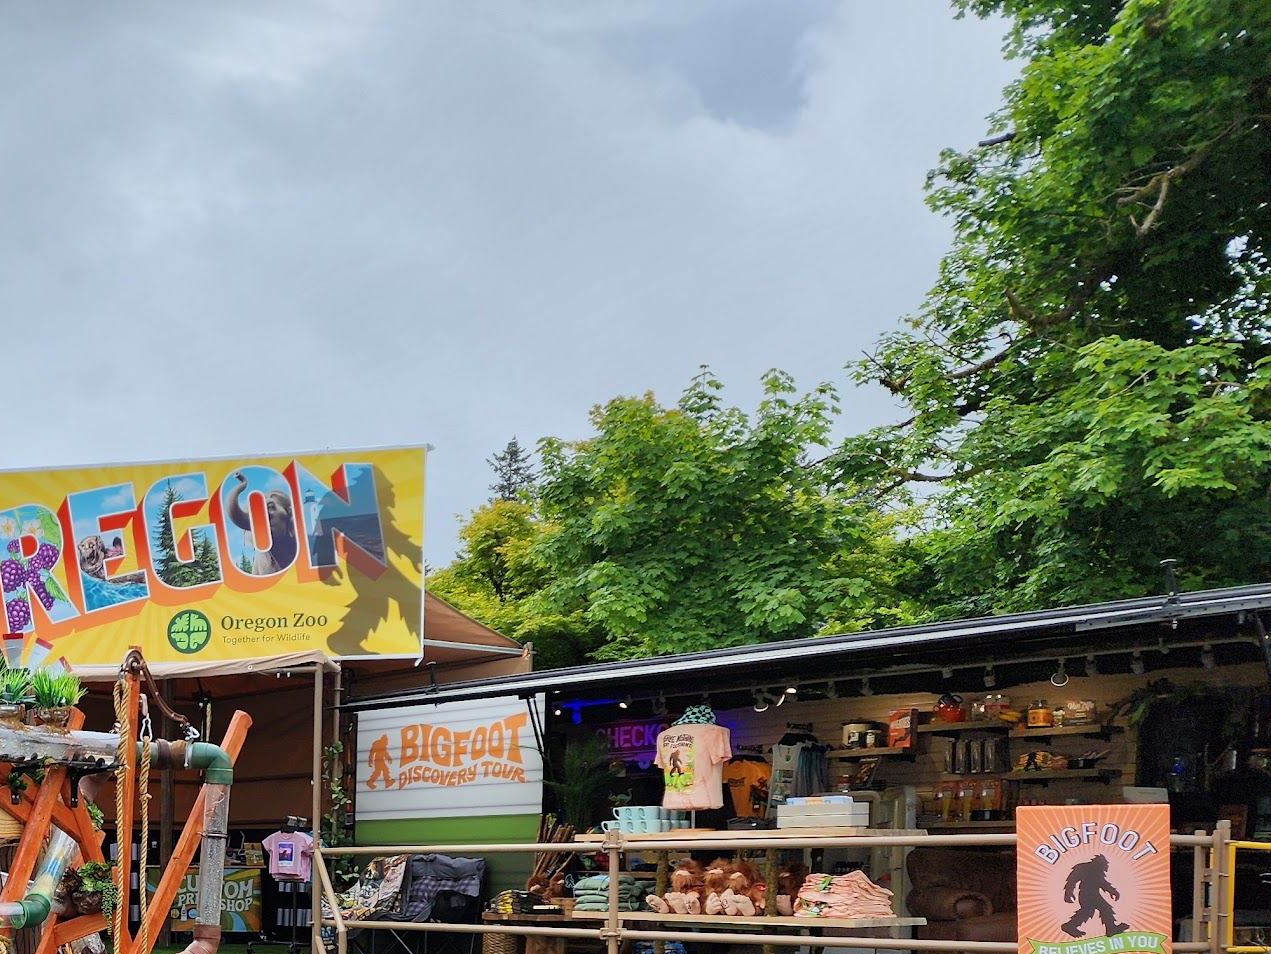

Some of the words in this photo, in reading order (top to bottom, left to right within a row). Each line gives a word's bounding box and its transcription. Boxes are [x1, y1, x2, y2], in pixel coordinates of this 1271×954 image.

[221, 615, 288, 632] Oregon
[293, 613, 328, 628] Zoo
[222, 635, 259, 645] Together
[262, 634, 274, 642] for
[277, 633, 310, 642] Wildlife
[399, 712, 528, 768] BIGFOOT
[399, 763, 478, 790] DISCOVERY
[481, 760, 526, 783] TOUR
[1034, 822, 1158, 865] BIGFOOT
[177, 875, 254, 899] CUOM
[178, 893, 200, 907] PRI
[220, 897, 253, 912] SHOP
[1109, 937, 1124, 950] IN
[1128, 935, 1158, 949] YOU
